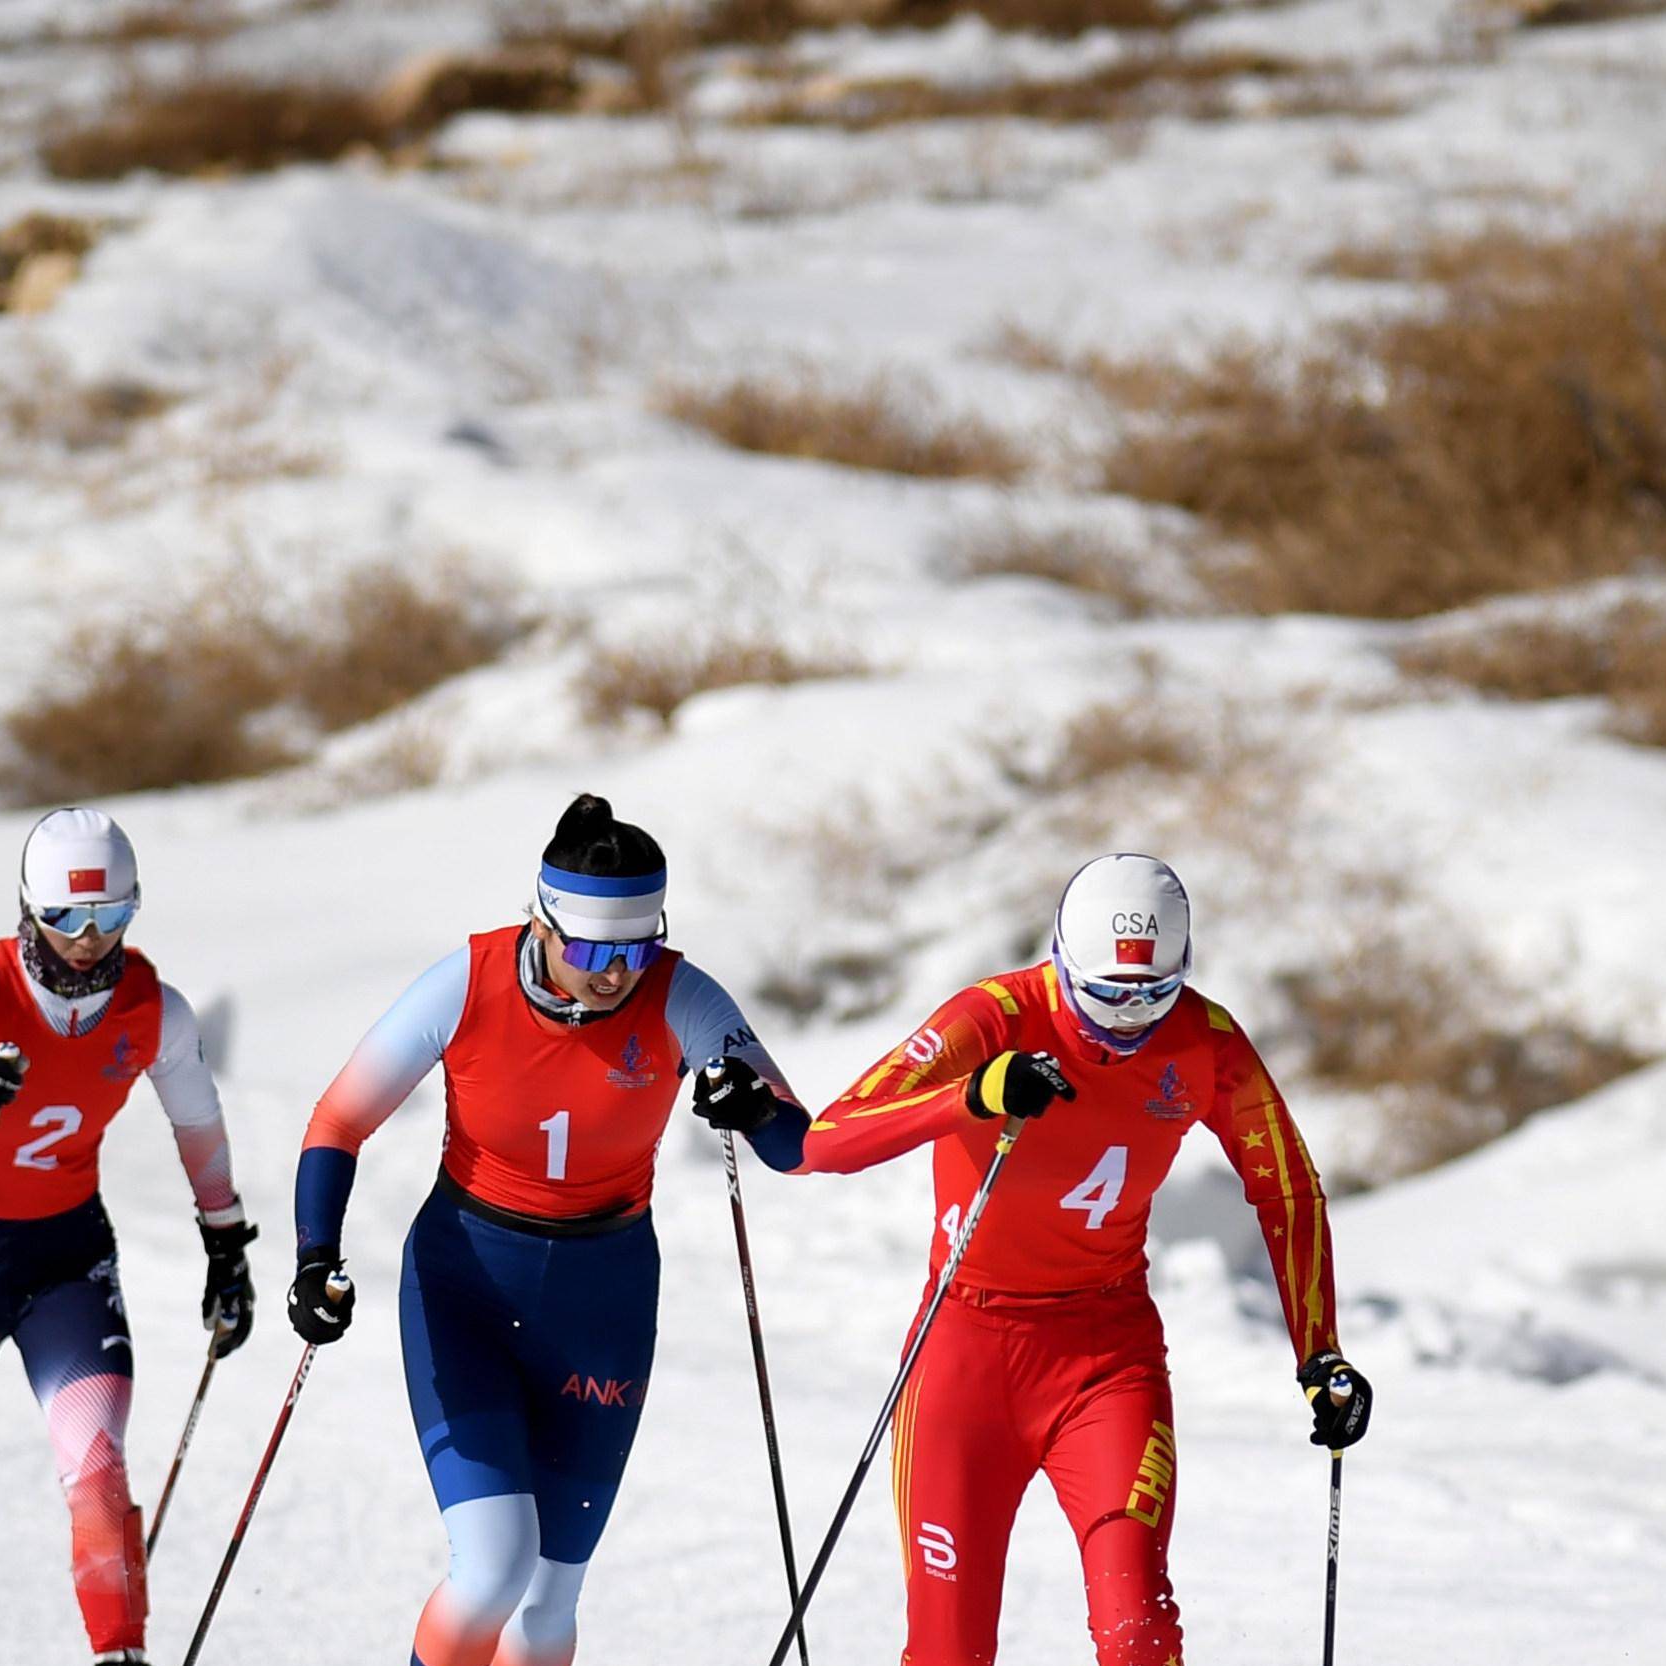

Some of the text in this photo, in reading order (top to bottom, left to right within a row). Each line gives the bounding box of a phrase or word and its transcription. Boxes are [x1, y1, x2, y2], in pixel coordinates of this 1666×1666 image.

[1112, 912, 1159, 936] CSA
[13, 1105, 83, 1171] 2
[539, 1110, 570, 1181] 1
[1059, 1146, 1128, 1230] 4
[1125, 1420, 1175, 1528] CHINA
